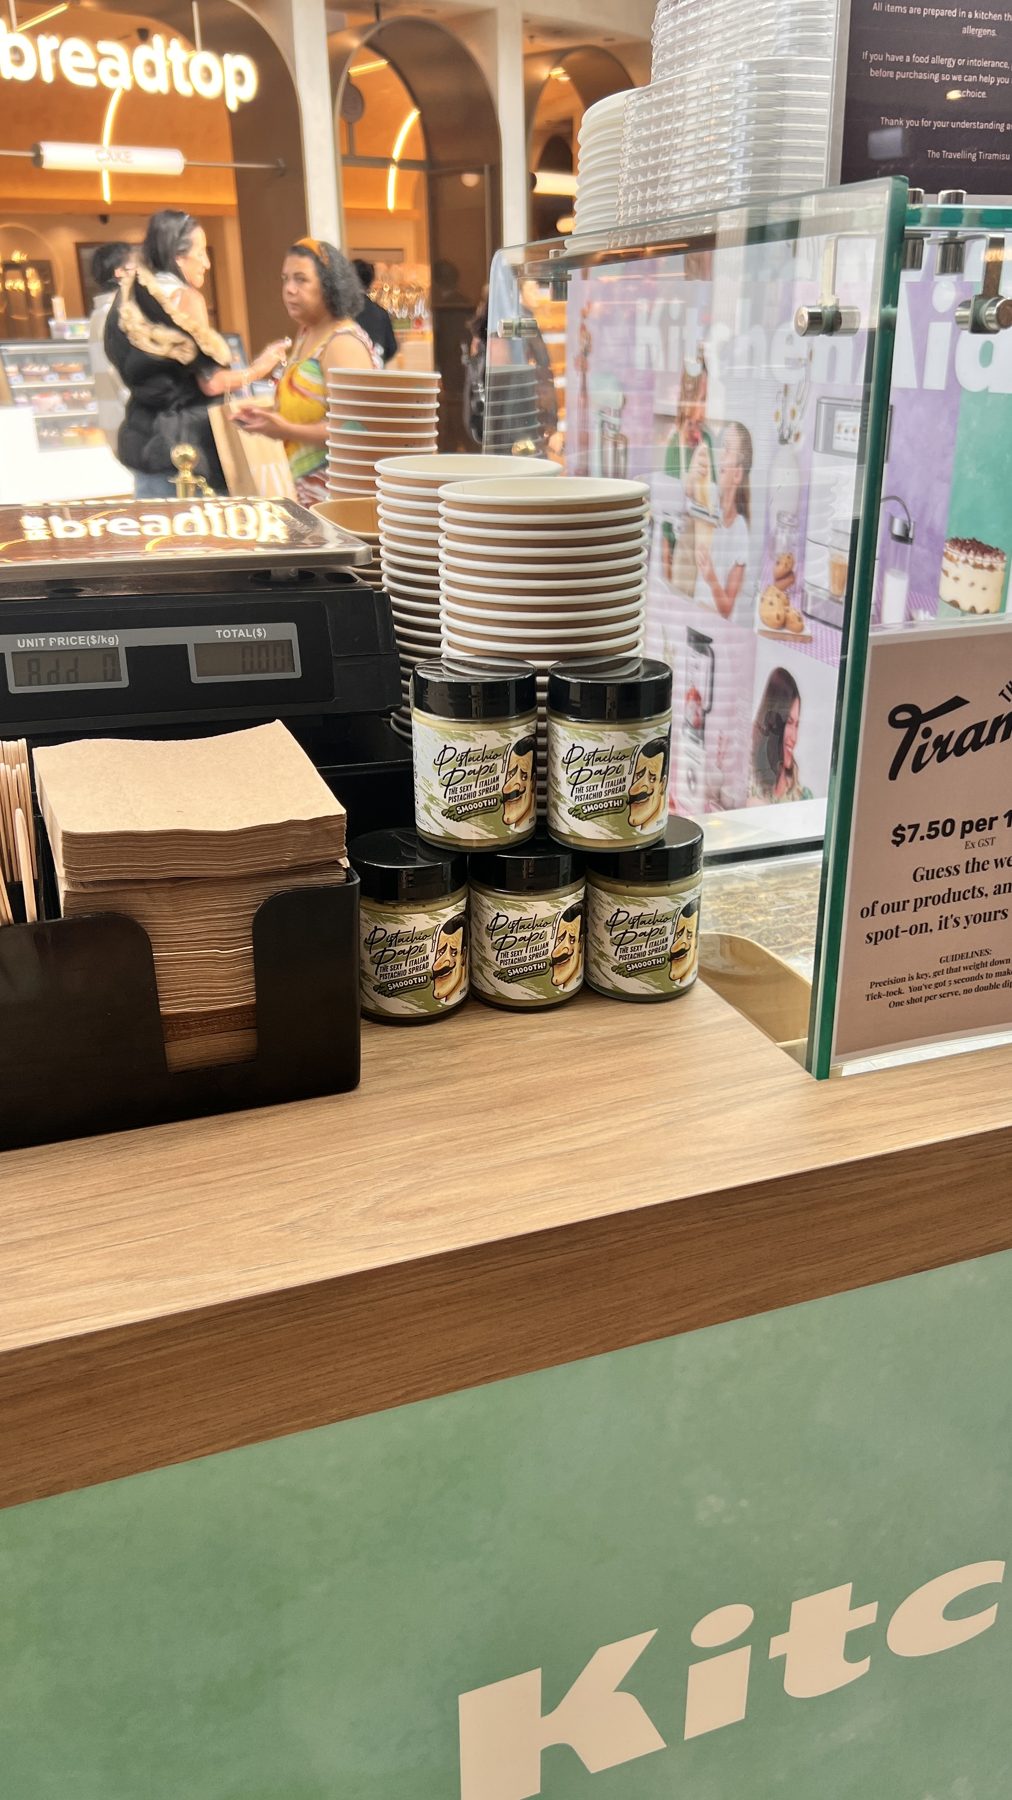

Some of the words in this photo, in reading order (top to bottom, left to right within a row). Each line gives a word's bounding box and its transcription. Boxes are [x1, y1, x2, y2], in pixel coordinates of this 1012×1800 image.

[873, 3, 882, 11] All
[884, 4, 907, 14] items
[909, 6, 921, 15] are
[923, 7, 956, 18] prepared
[959, 8, 966, 18] in
[974, 10, 1002, 20] kitchen
[0, 18, 258, 112] breadtop
[862, 51, 868, 59] If
[869, 53, 883, 62] you
[886, 51, 903, 62] have
[905, 54, 910, 62] a
[912, 52, 929, 63] food
[931, 54, 956, 67] allergy
[967, 57, 1010, 69] intolerance,
[870, 68, 894, 77] before
[896, 70, 940, 83] purchasing
[979, 74, 995, 85] help
[996, 76, 1010, 86] you
[881, 117, 903, 126] Thank
[905, 119, 920, 128] you
[921, 118, 932, 127] for
[932, 120, 950, 130] your
[951, 120, 1005, 132] understanding
[927, 150, 940, 159] The
[942, 149, 977, 162] Travelling
[978, 151, 1010, 161] Tiramisu
[17, 637, 46, 649] UNIT
[49, 634, 120, 649] PRICE($/kg)
[215, 627, 267, 640] TOTAL($)
[434, 744, 502, 776] Pistachio
[562, 743, 631, 774] Pistachio
[440, 763, 495, 799] Papi
[448, 786, 458, 795] THE
[460, 784, 473, 793] SEXY
[479, 775, 500, 788] ITALIAN
[567, 764, 622, 797] Papi
[575, 786, 584, 794] THE
[586, 784, 599, 792] SEXY
[605, 776, 627, 789] ITALIAN
[448, 791, 477, 803] PISTACHIO
[478, 783, 500, 797] SPREAD
[574, 791, 603, 802] PISTACHIO
[604, 785, 627, 798] SPREAD
[891, 818, 955, 848] $7.50
[960, 816, 998, 839] per
[964, 840, 976, 850] Ex
[977, 837, 996, 848] GST
[912, 863, 961, 883] Guess
[964, 857, 990, 874] the
[860, 900, 879, 919] of
[880, 899, 910, 915] our
[487, 912, 551, 940] Pistachio
[606, 908, 671, 936] Pistachio
[937, 914, 961, 931] it's
[963, 908, 1009, 929] yours
[365, 926, 432, 954] Pistachio
[492, 930, 544, 961] Papi
[500, 951, 509, 959] THE
[511, 949, 523, 957] SEXY
[529, 941, 549, 953] ITALIAN
[611, 926, 665, 956] Papi
[619, 946, 628, 954] THE
[630, 944, 642, 953] SEXY
[649, 937, 668, 948] ITALIAN
[370, 943, 424, 975] Papi
[500, 955, 527, 966] PISTACHIO
[528, 948, 549, 961] SPREAD
[619, 951, 647, 961] PISTACHIO
[648, 944, 668, 956] SPREAD
[939, 948, 992, 964] GUIDELINES:
[380, 970, 407, 980] PISTACHIO
[408, 962, 429, 975] SPREAD
[390, 963, 402, 972] SEXY
[409, 954, 429, 966] ITALIAN
[869, 976, 906, 989] Precision
[907, 973, 915, 983] is
[933, 966, 945, 978] get
[946, 965, 961, 975] that
[962, 960, 988, 972] weight
[989, 957, 1011, 968] down
[908, 982, 933, 995] You've
[934, 980, 947, 991] got
[953, 972, 984, 985] seconds
[985, 971, 994, 980] to
[888, 998, 905, 1009] One
[906, 994, 923, 1007] shot
[924, 992, 938, 1004] per
[963, 987, 973, 995] no
[974, 982, 1000, 993] double
[458, 1560, 1006, 1800] Kitc
